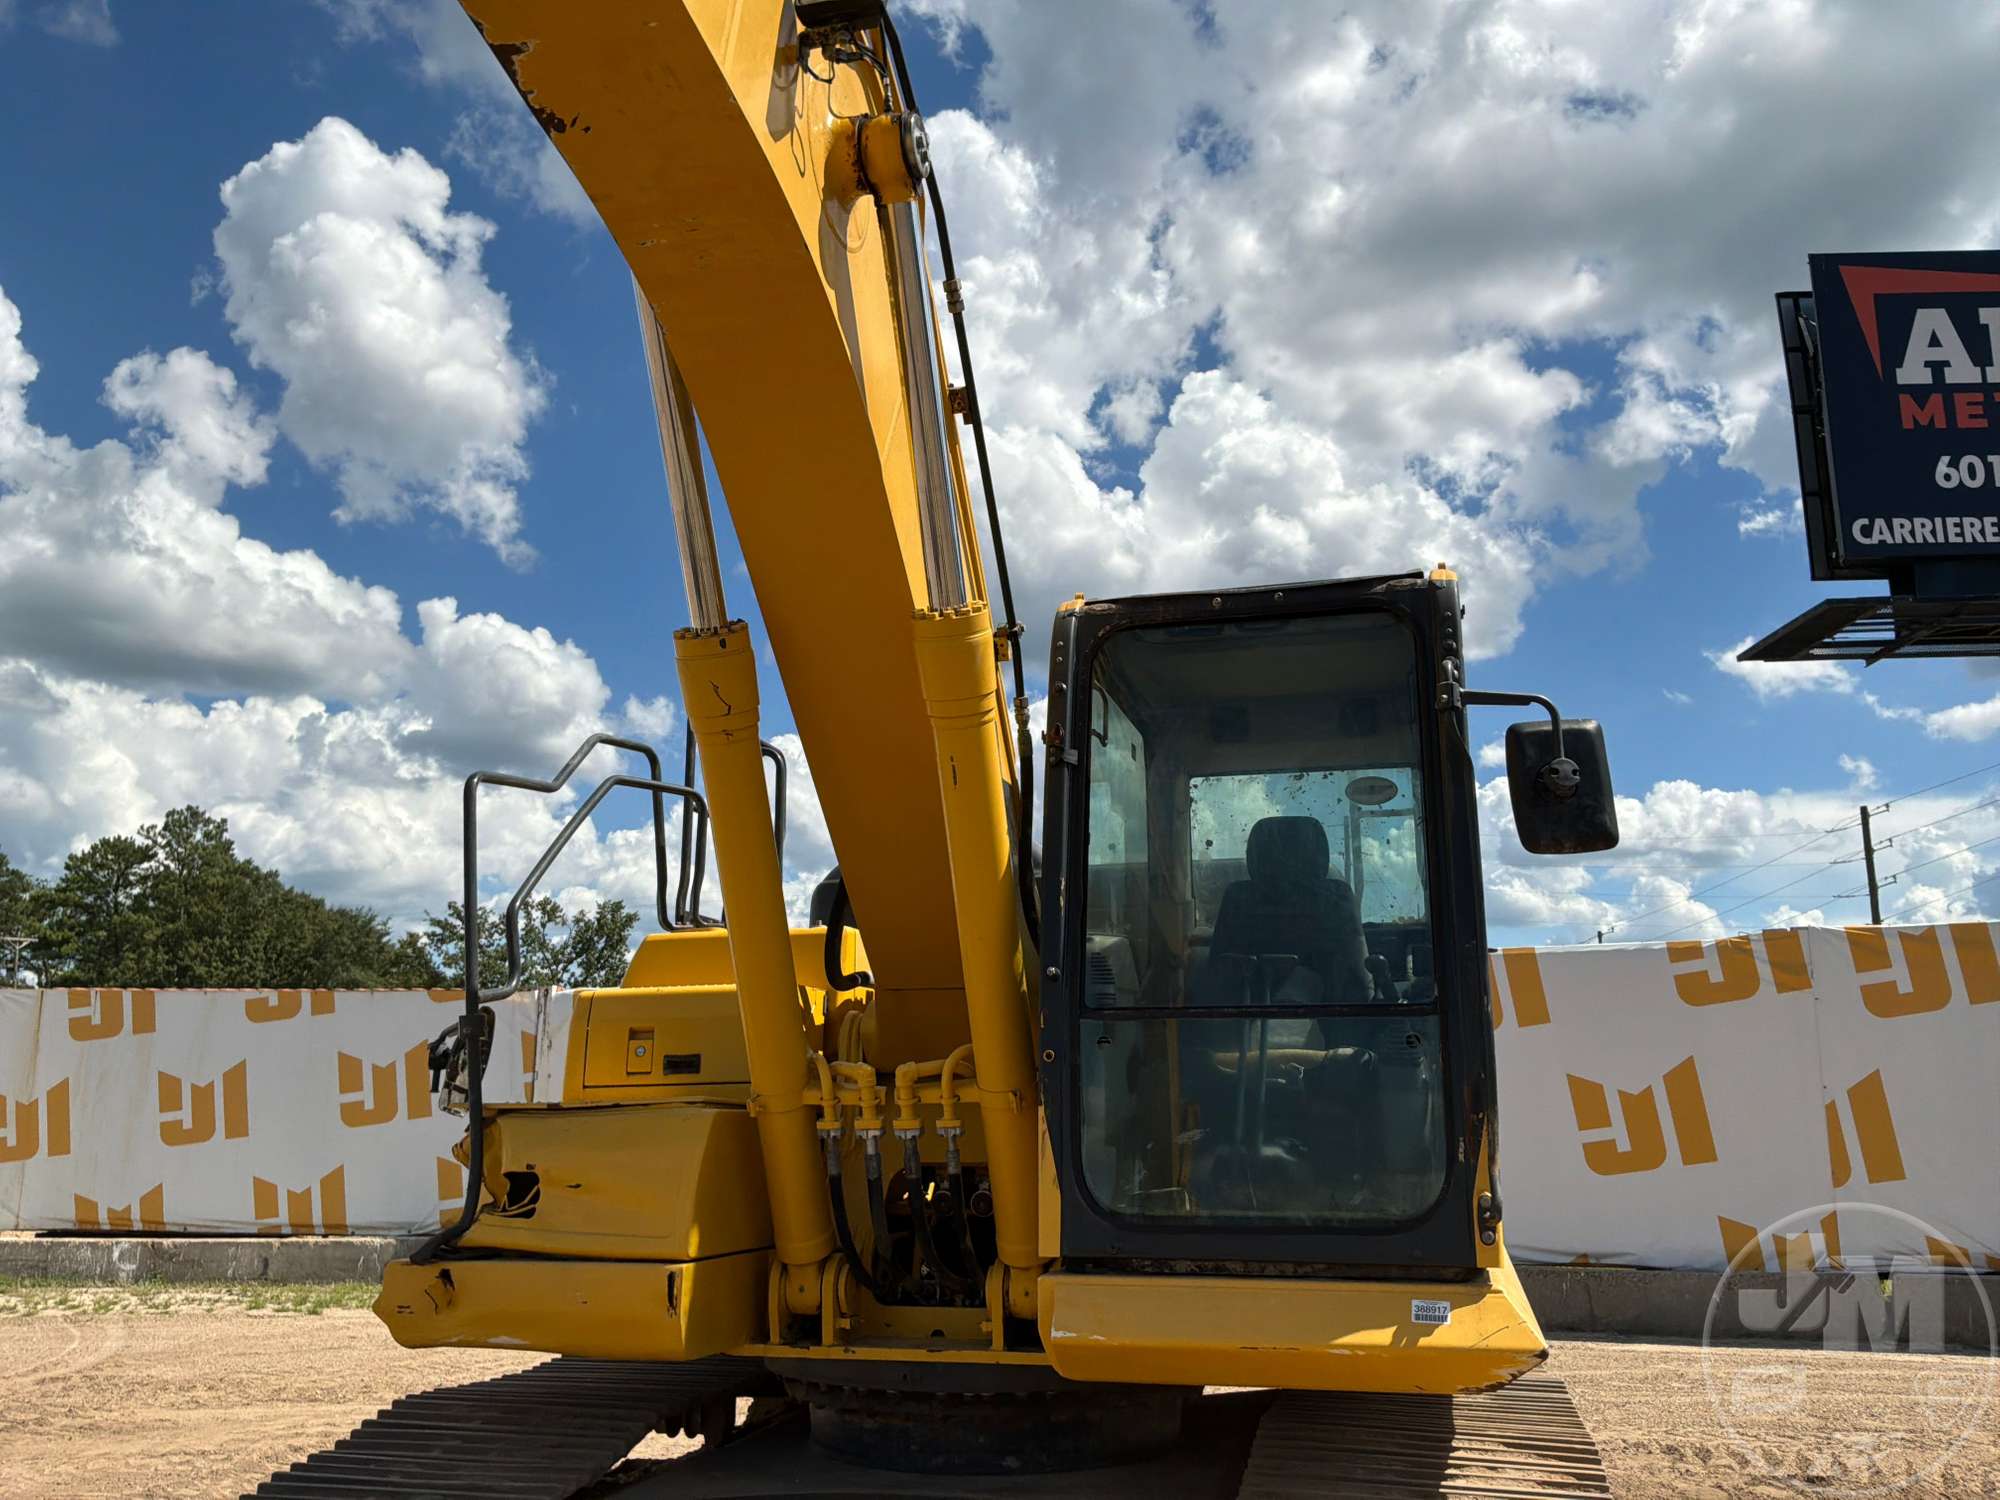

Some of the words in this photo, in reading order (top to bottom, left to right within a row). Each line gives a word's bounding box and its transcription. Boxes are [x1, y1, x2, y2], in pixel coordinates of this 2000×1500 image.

[1898, 392, 2000, 429] ME
[1851, 516, 2000, 544] CARRIERE
[1414, 1304, 1448, 1315] 388917
